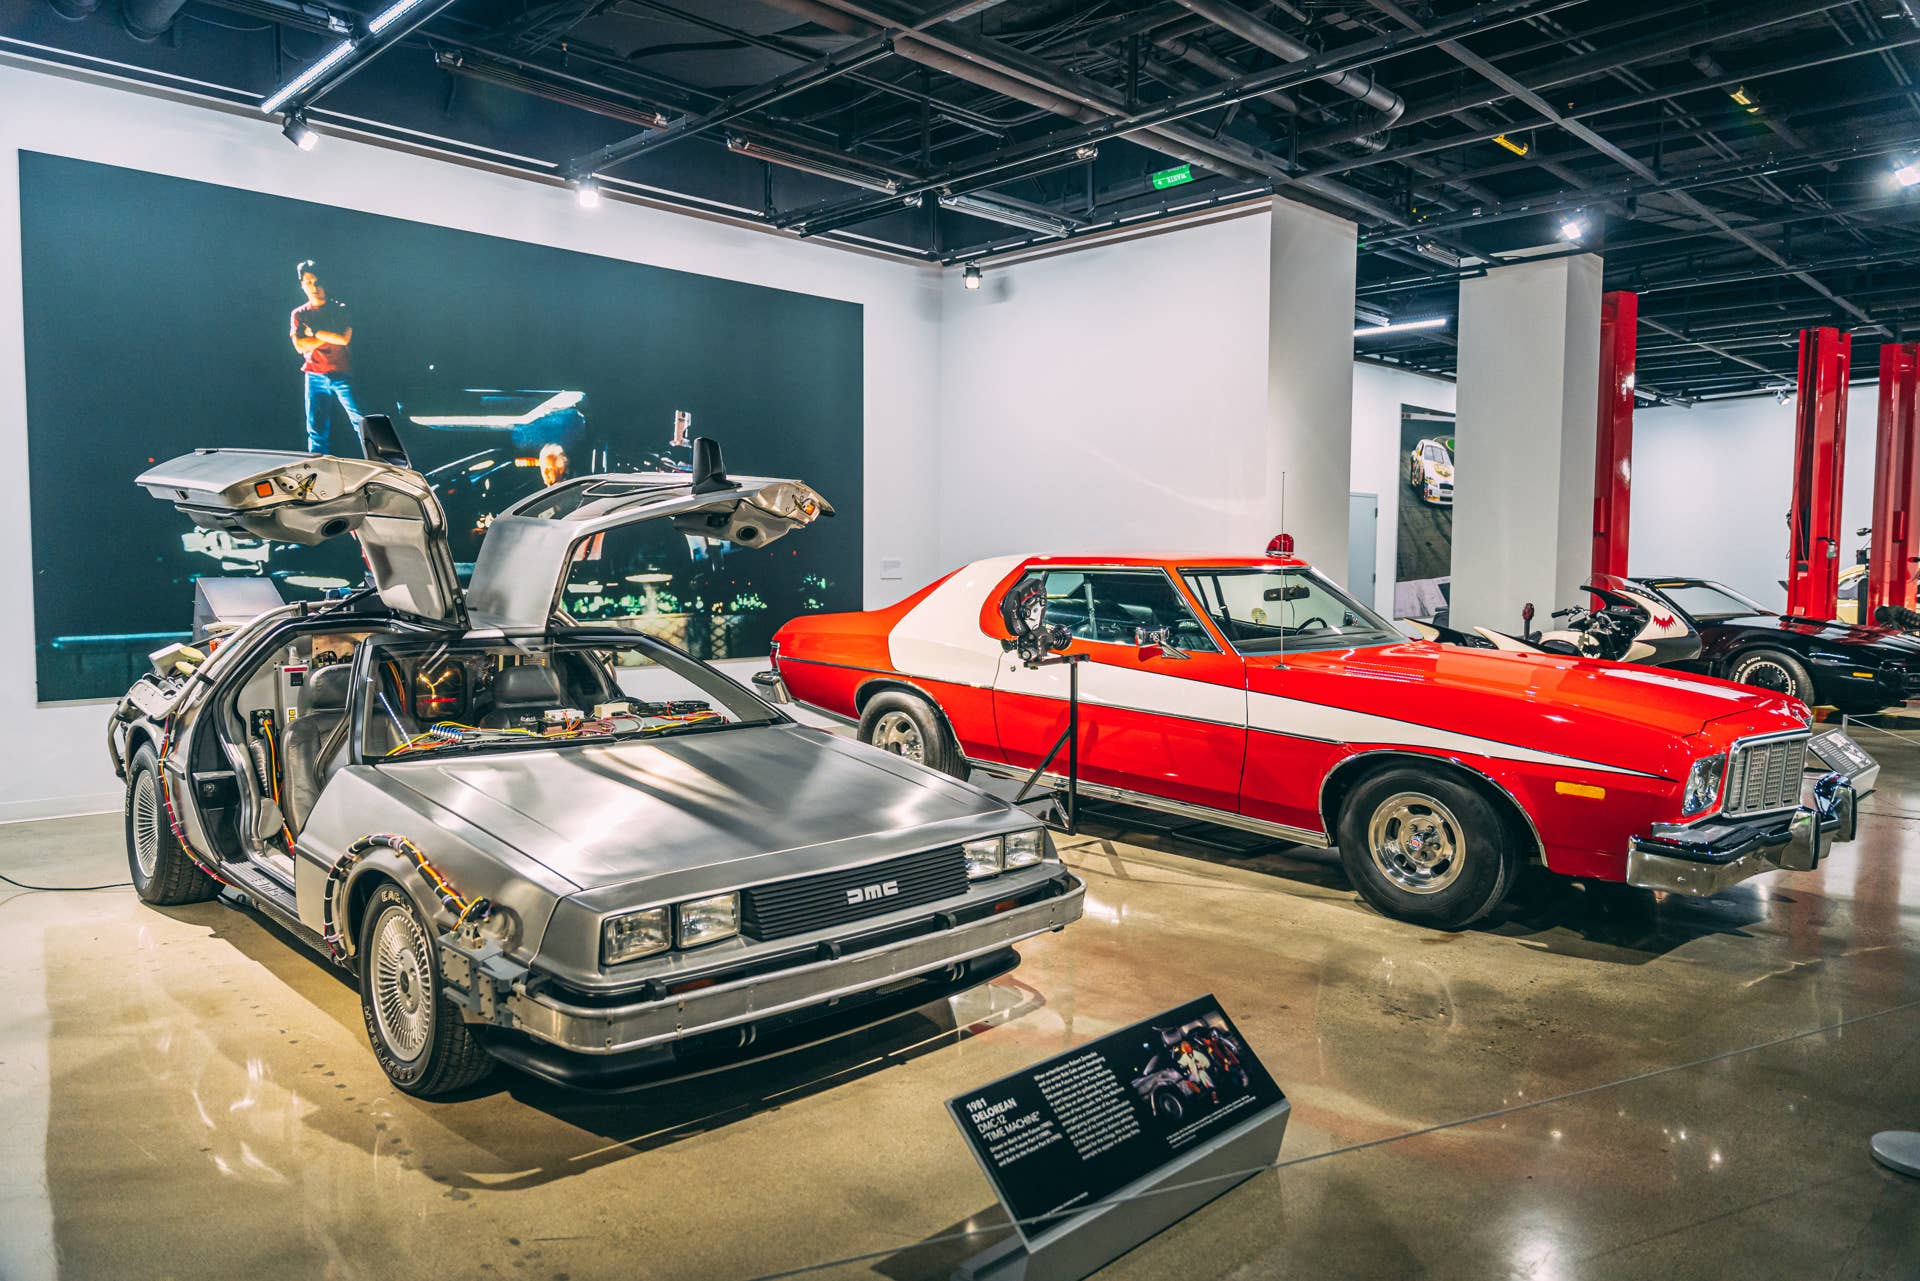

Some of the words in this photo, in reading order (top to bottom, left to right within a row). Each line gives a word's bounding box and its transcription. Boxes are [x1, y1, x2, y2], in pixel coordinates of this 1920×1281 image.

[381, 890, 412, 914] EAGLE
[847, 881, 898, 904] DMC
[363, 1005, 412, 1080] GOODYEAR
[966, 1098, 987, 1112] 1981
[972, 1098, 1016, 1123] DELOREAN
[977, 1114, 1007, 1133] DMC-12
